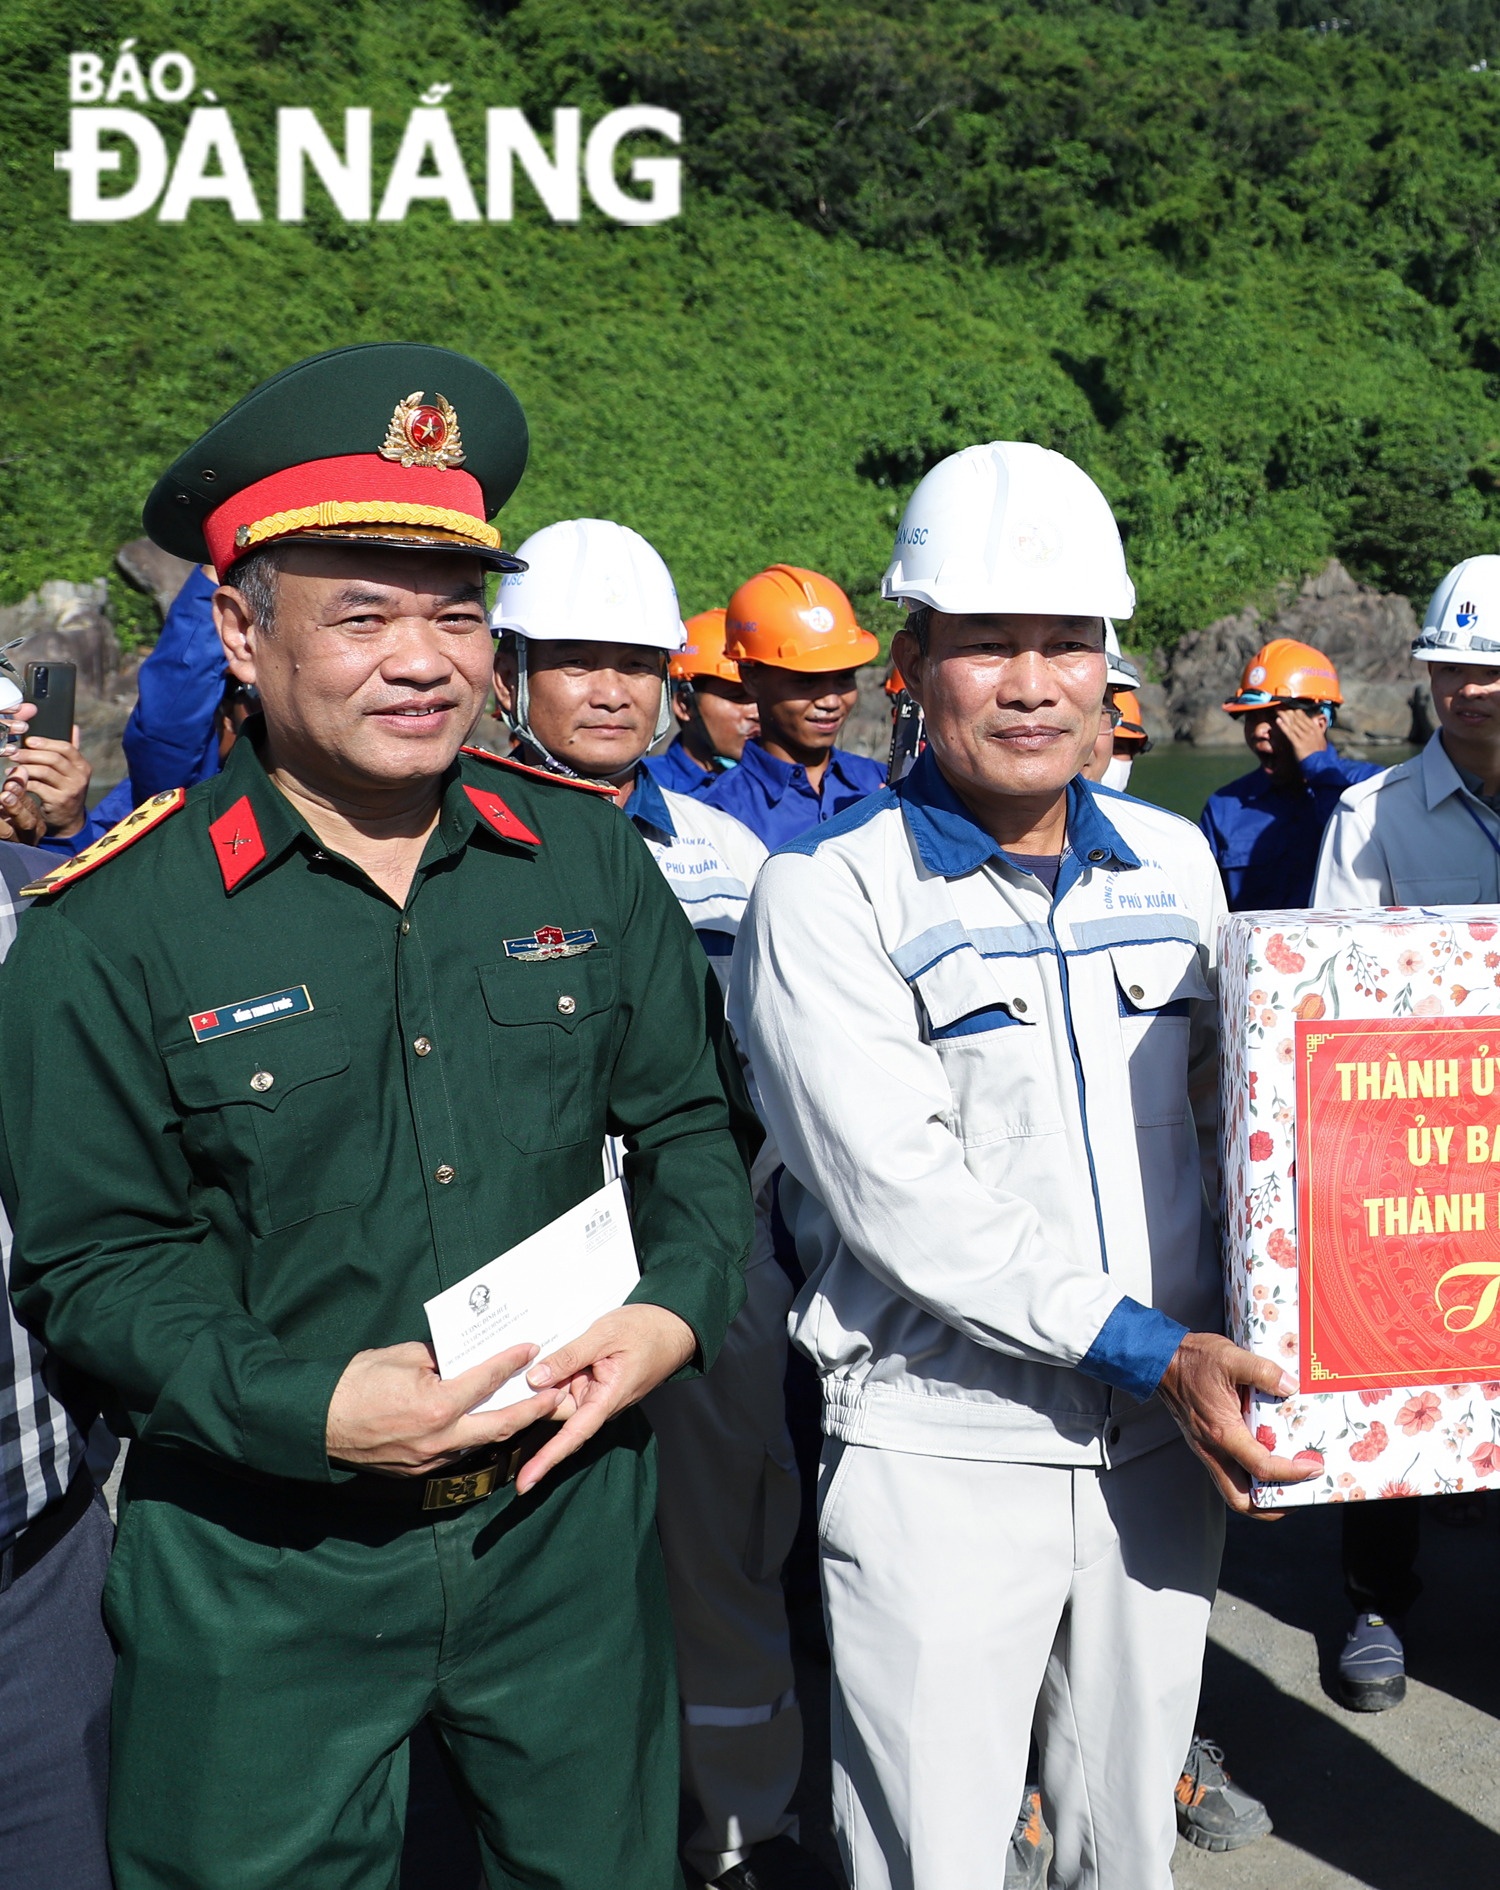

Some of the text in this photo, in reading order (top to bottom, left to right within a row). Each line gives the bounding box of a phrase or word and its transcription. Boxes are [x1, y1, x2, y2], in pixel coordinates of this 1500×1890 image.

[908, 527, 928, 546] JSC
[665, 861, 685, 875] PHÚ
[688, 859, 718, 875] XUÂN
[1118, 890, 1177, 909] PHÚ XUÂN
[1335, 1051, 1459, 1102] THÀNH
[1407, 1114, 1455, 1167] ỦY
[1363, 1187, 1486, 1237] THÀNH
